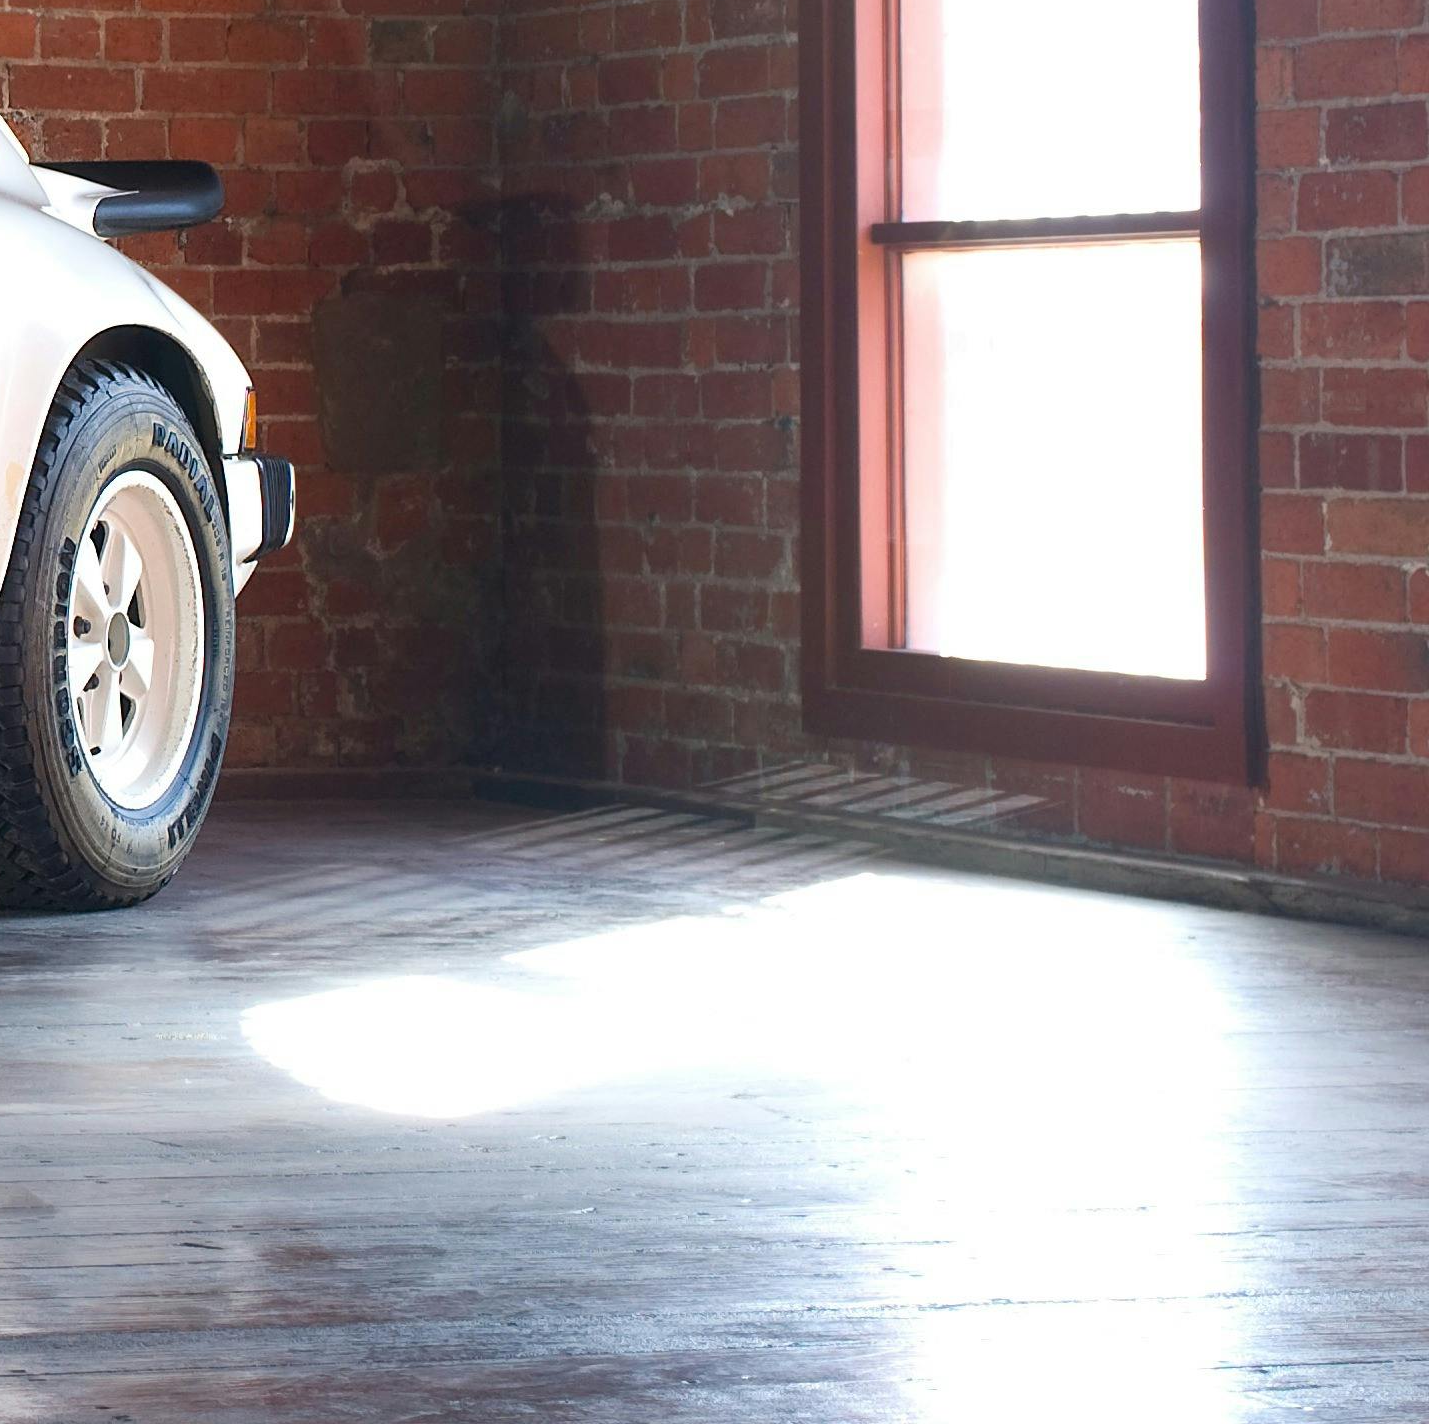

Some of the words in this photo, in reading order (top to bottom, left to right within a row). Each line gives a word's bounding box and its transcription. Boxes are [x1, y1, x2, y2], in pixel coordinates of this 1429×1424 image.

[152, 422, 215, 523] RADIAL
[53, 536, 82, 777] SCORPION
[167, 731, 223, 850] PIRELLI
